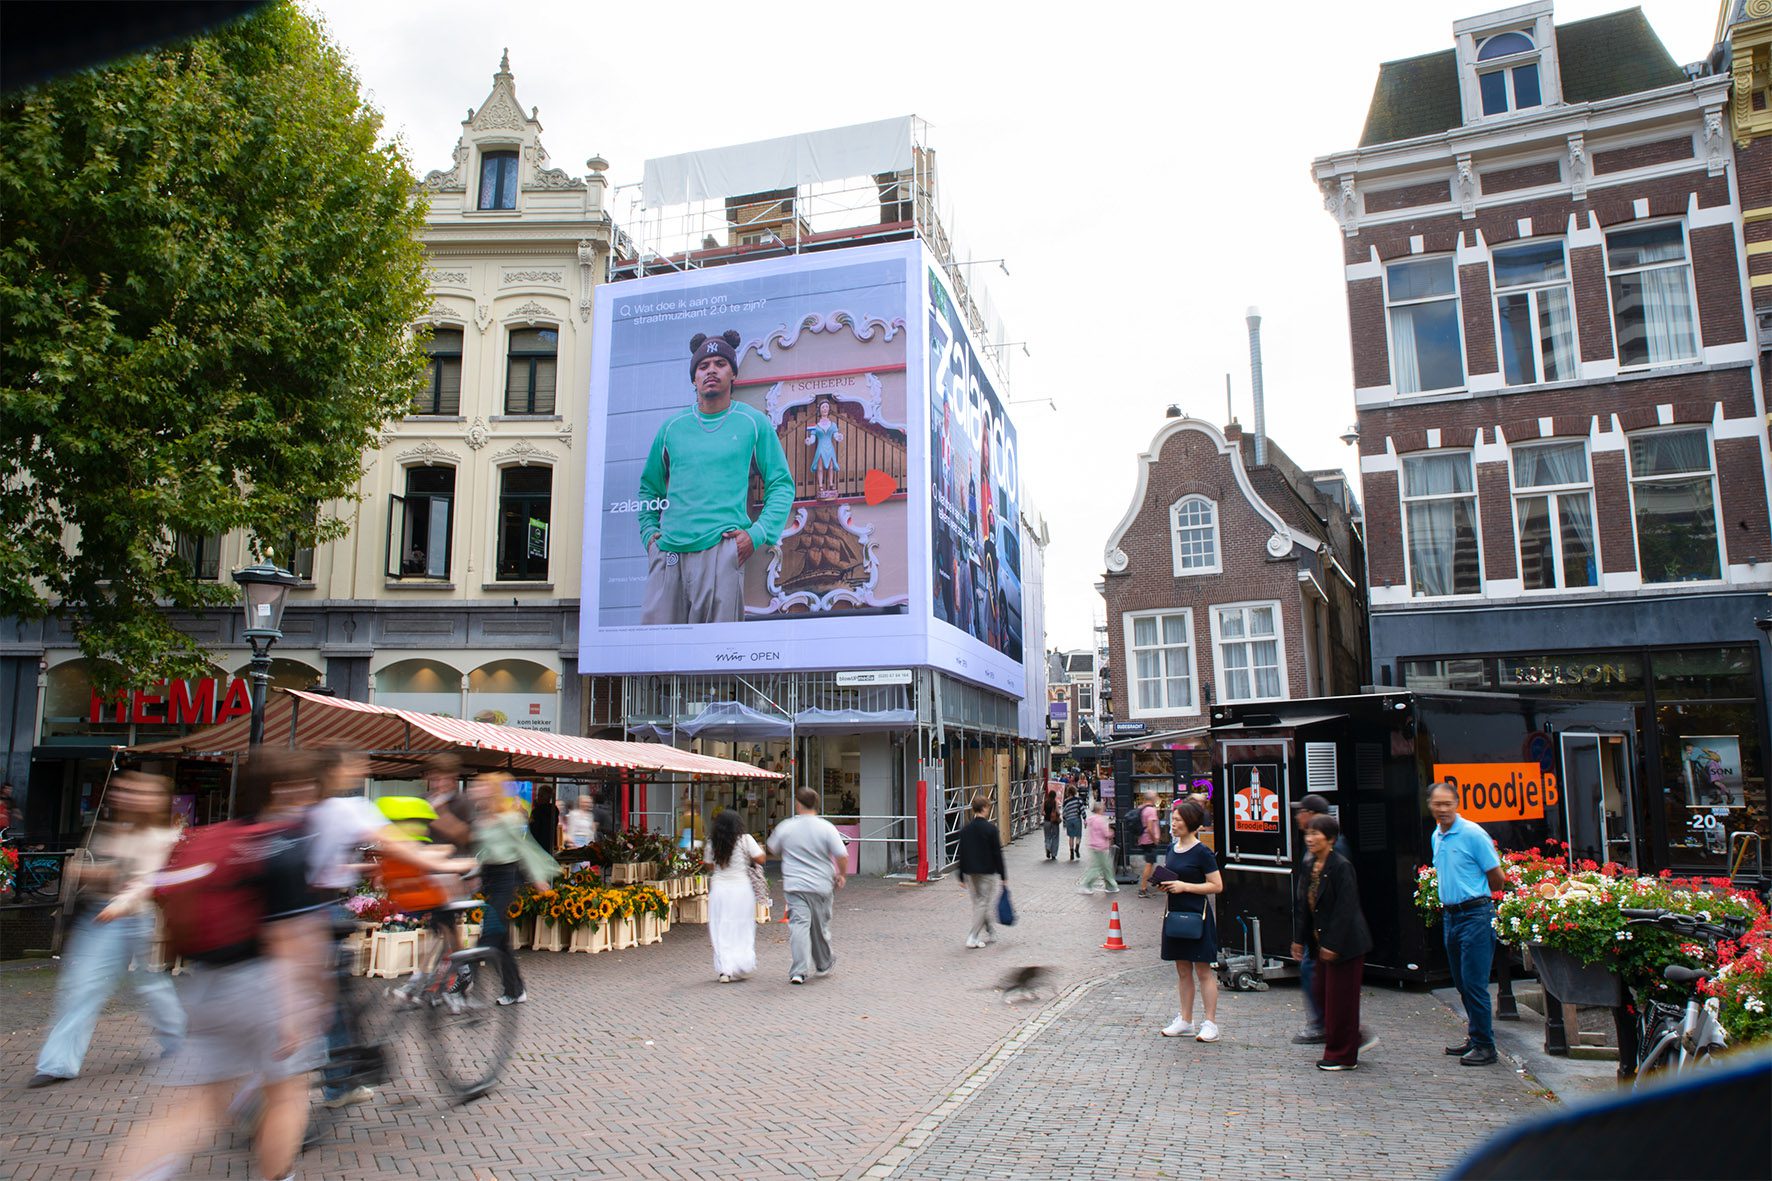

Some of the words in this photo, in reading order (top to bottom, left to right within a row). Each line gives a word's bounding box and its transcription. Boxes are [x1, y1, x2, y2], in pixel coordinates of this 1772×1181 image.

[633, 308, 707, 325] straatmuzikant
[710, 304, 727, 316] 2.0
[730, 303, 741, 313] te
[743, 299, 767, 313] zijn?
[634, 305, 653, 314] Wat
[656, 302, 676, 311] doe
[678, 299, 687, 308] ik
[689, 298, 709, 308] aan
[710, 295, 727, 304] om
[798, 377, 856, 391] SCHEEPJE
[929, 298, 1017, 504] zalando
[610, 497, 670, 514] zalando
[750, 652, 780, 662] OPEN
[90, 677, 254, 724] HEMA
